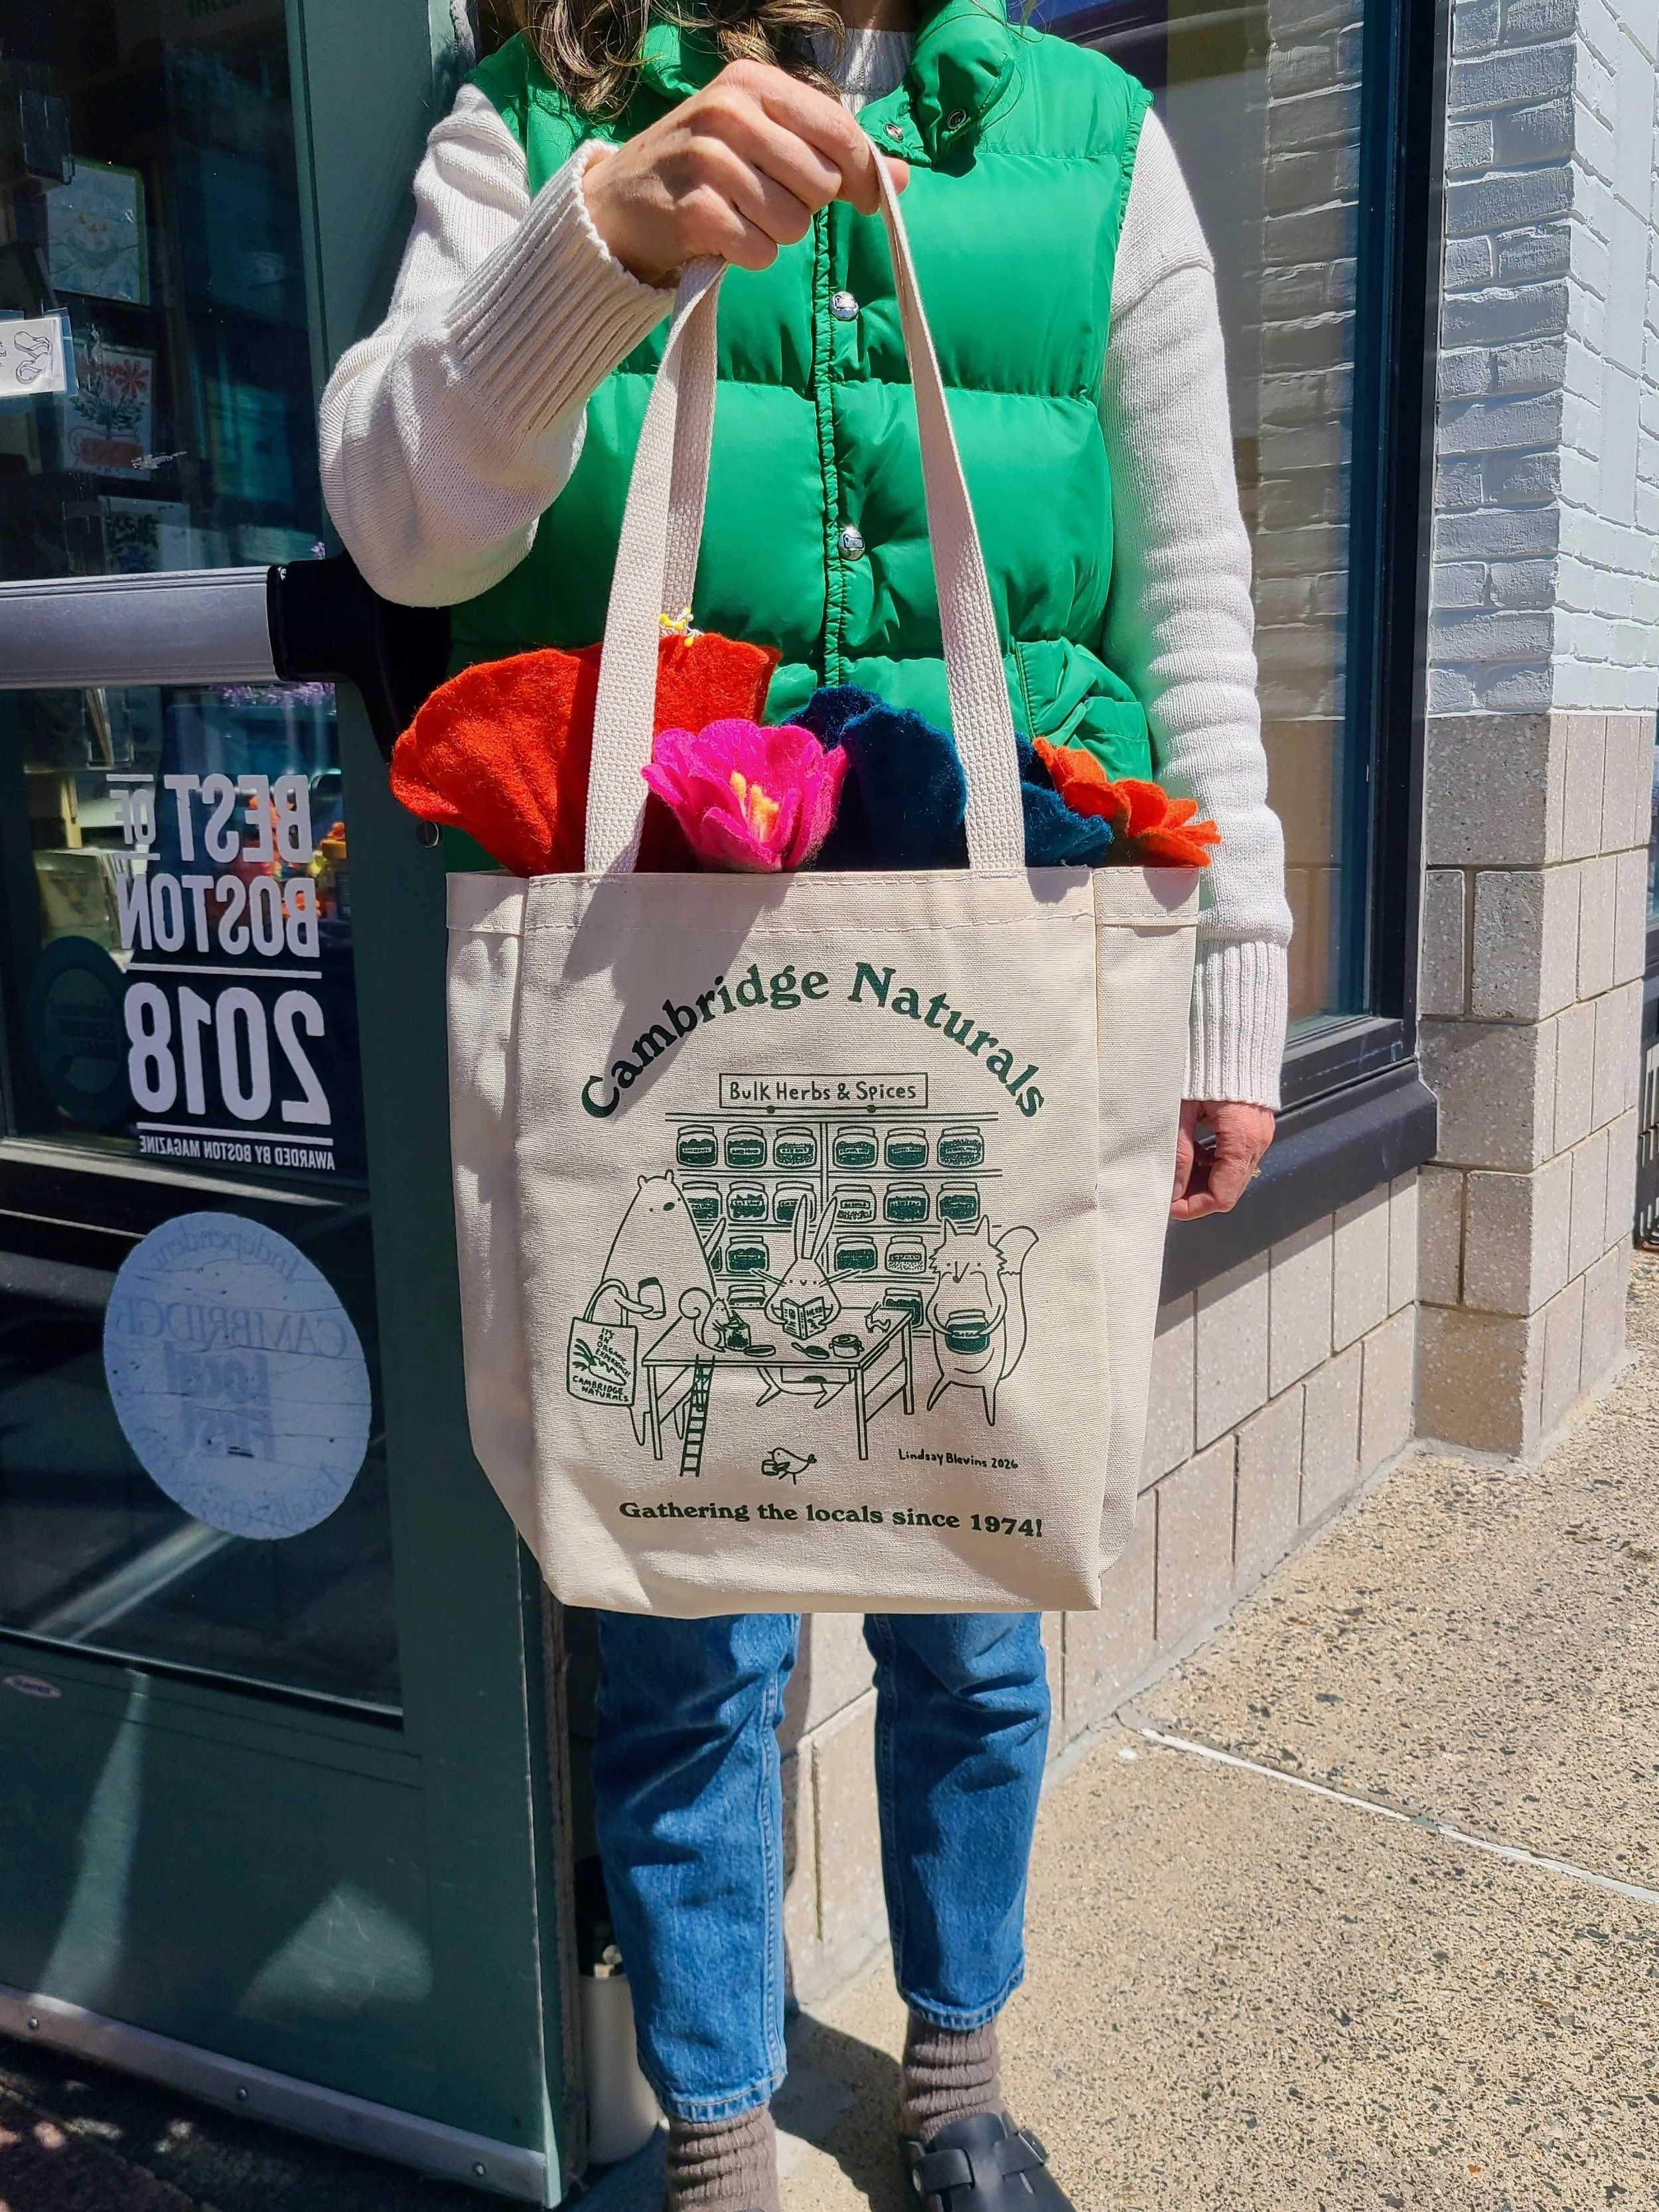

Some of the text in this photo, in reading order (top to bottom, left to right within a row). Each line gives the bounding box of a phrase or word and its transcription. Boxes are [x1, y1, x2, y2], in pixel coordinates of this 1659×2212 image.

[581, 961, 1045, 1119] Cambridge Naturals
[730, 1081, 916, 1101] Bulk Herbs & Spices
[572, 1375, 624, 1395] CAMBRIDGE
[581, 1385, 629, 1403] NATURALS
[899, 1448, 1019, 1470] Lindsay Blevins 2026
[618, 1501, 1043, 1538] Gathering the locals since 1974!
